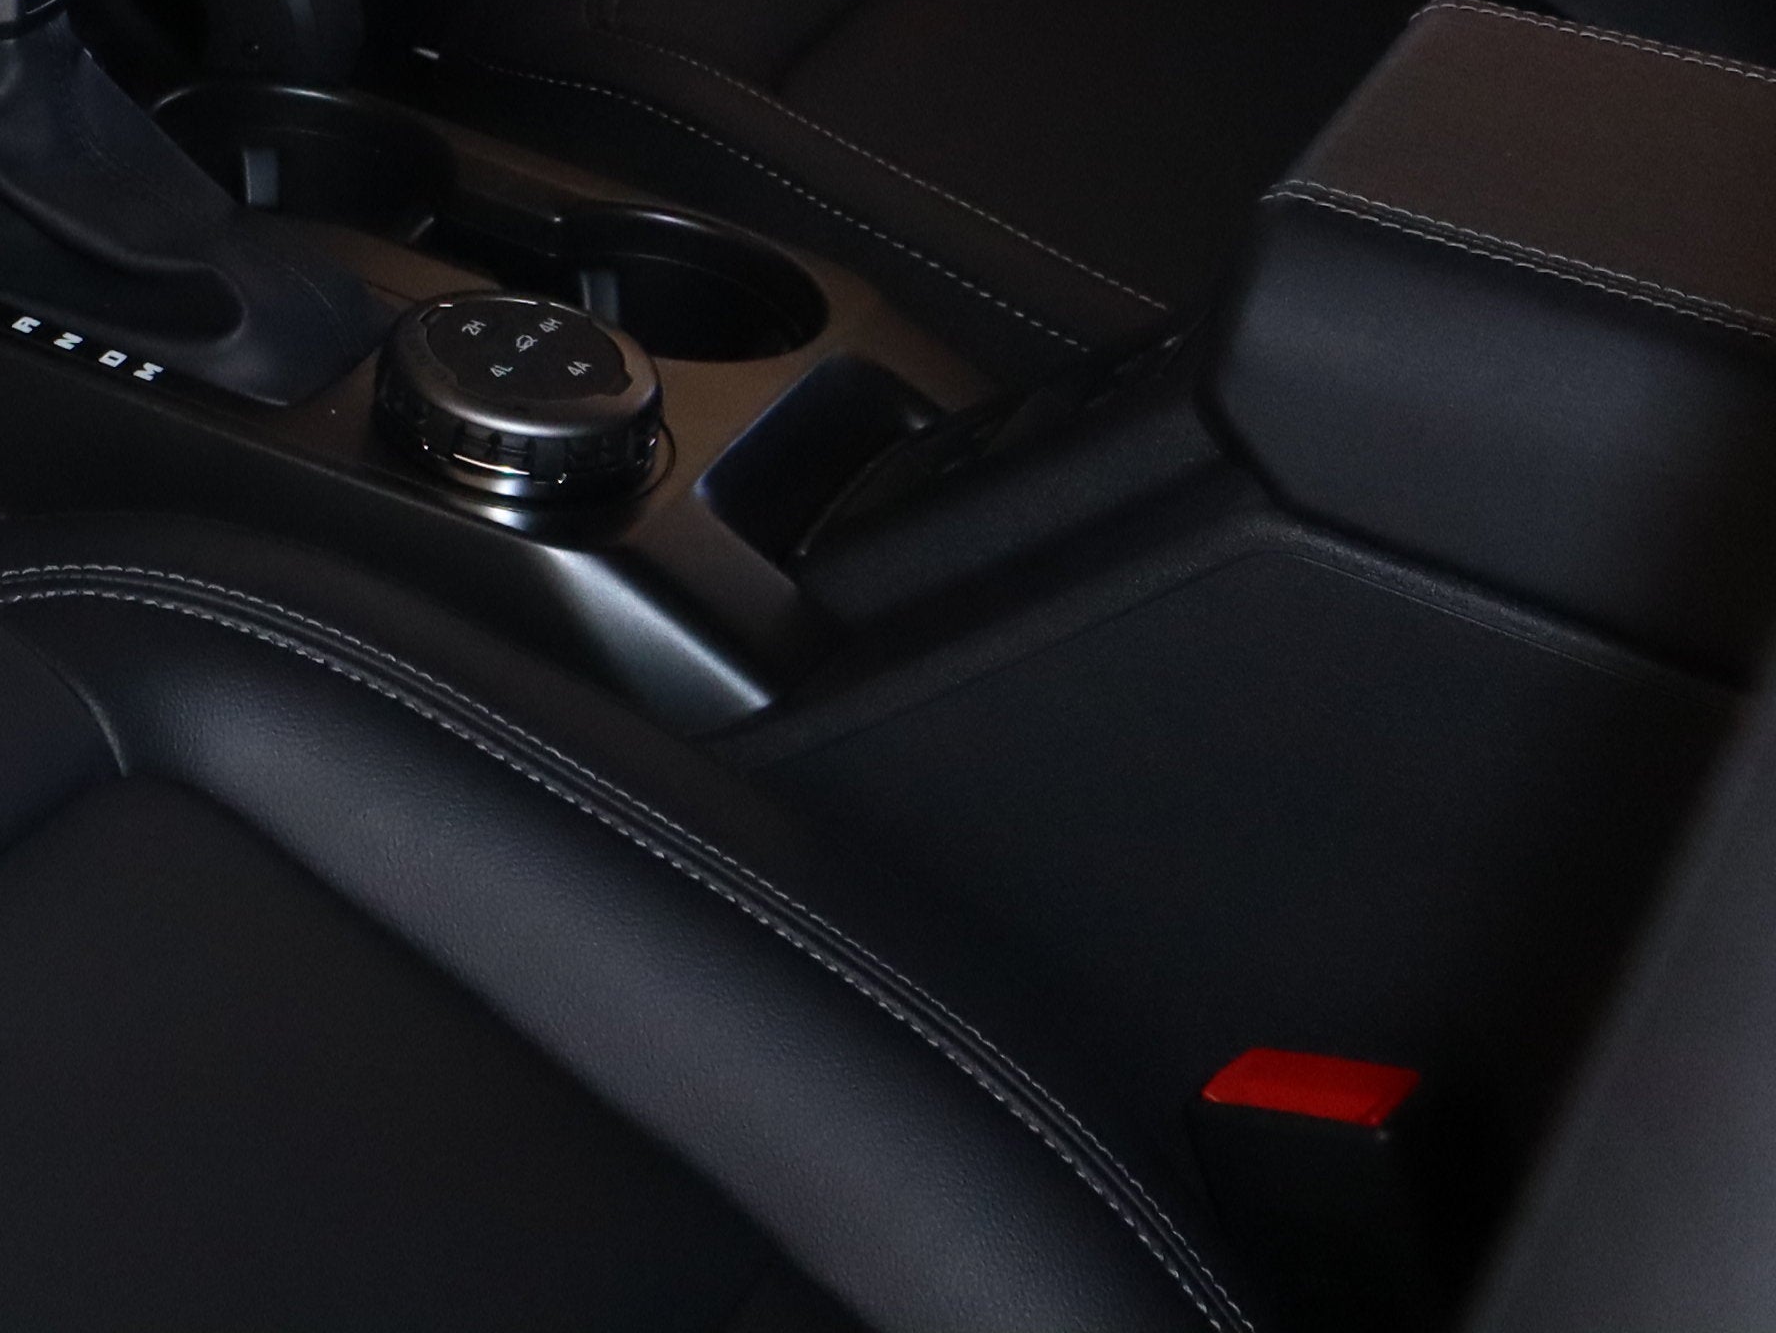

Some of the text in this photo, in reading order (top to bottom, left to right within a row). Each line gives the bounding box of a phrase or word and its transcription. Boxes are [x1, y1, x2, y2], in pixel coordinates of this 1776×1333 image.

[11, 315, 42, 334] R
[461, 319, 487, 336] 2H
[538, 317, 563, 333] 4H
[53, 331, 83, 350] N
[98, 349, 128, 368] D
[132, 361, 165, 381] M
[489, 364, 514, 378] 4L
[567, 360, 592, 376] 4A
